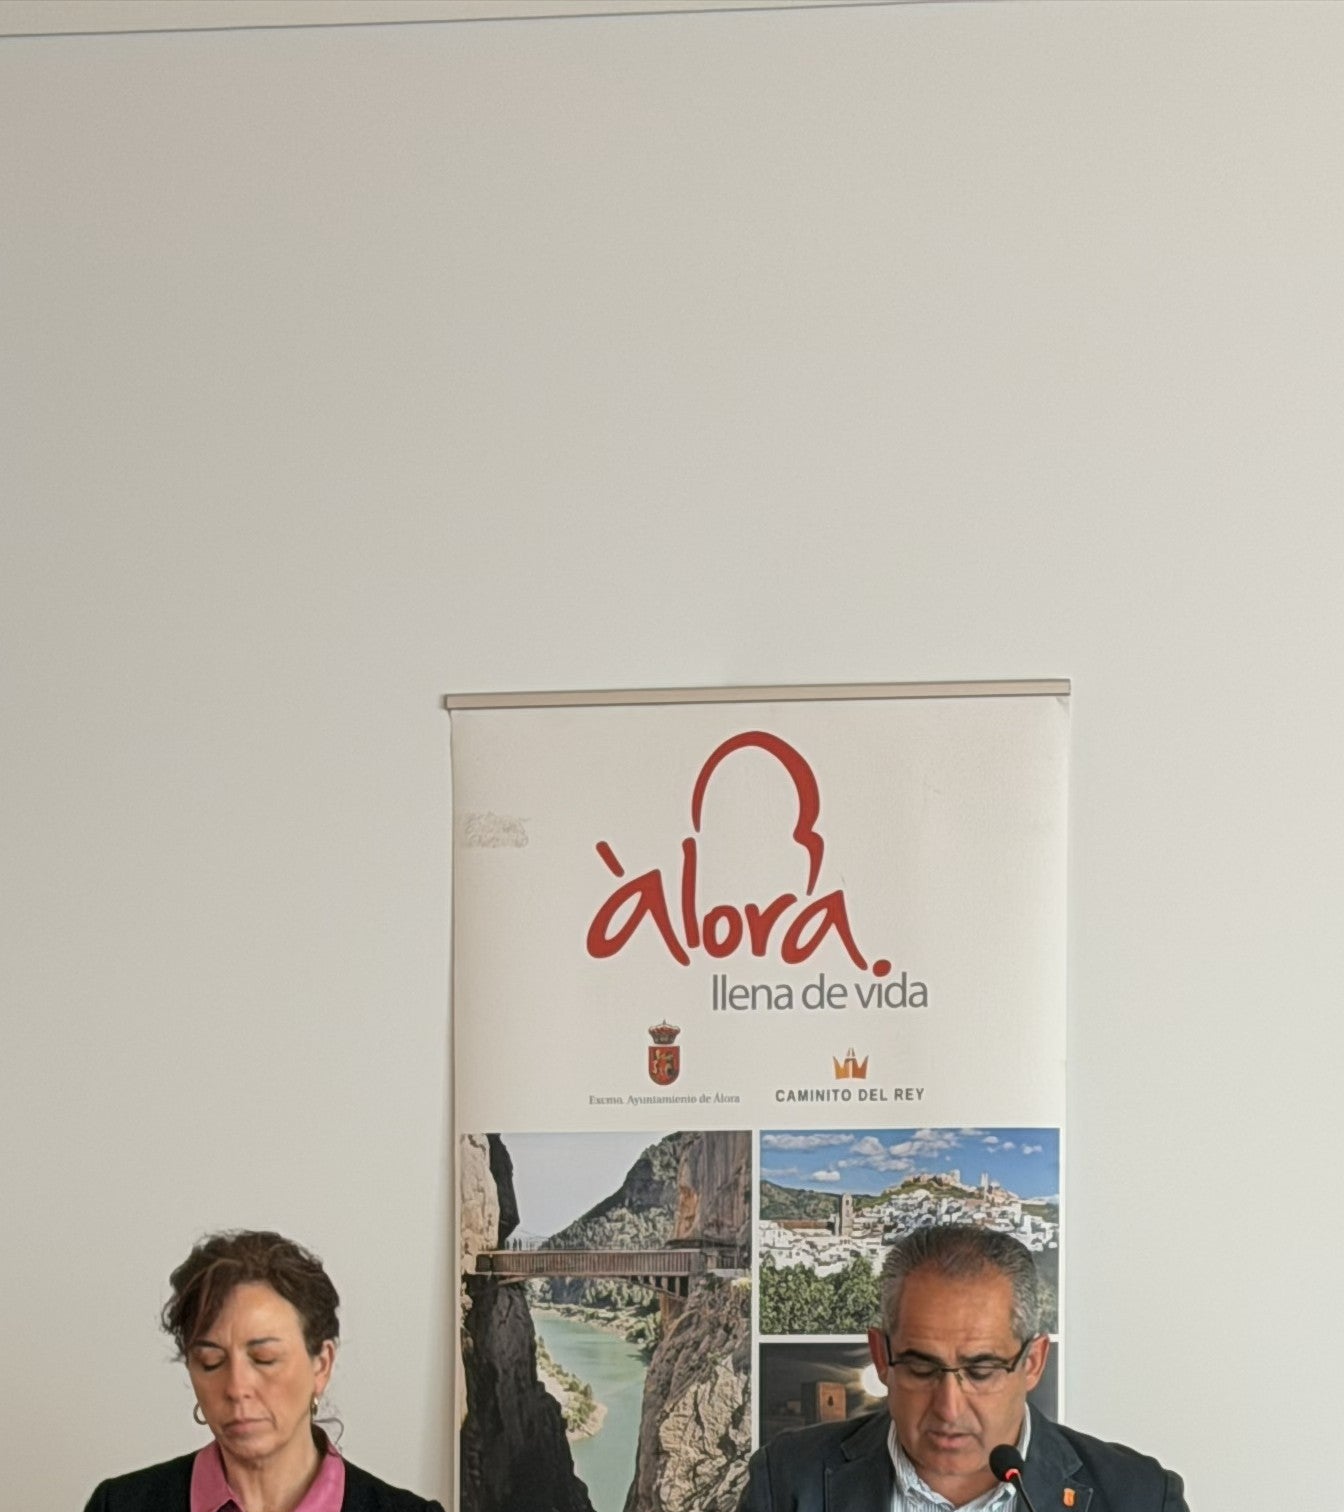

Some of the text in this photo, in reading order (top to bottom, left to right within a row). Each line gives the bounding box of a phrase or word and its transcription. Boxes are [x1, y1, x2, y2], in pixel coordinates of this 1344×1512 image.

[711, 970, 929, 1011] llena de vida
[627, 1094, 698, 1106] Ayuntamiento
[699, 1093, 710, 1104] de
[775, 1086, 926, 1103] CAMINITO DEL REY
